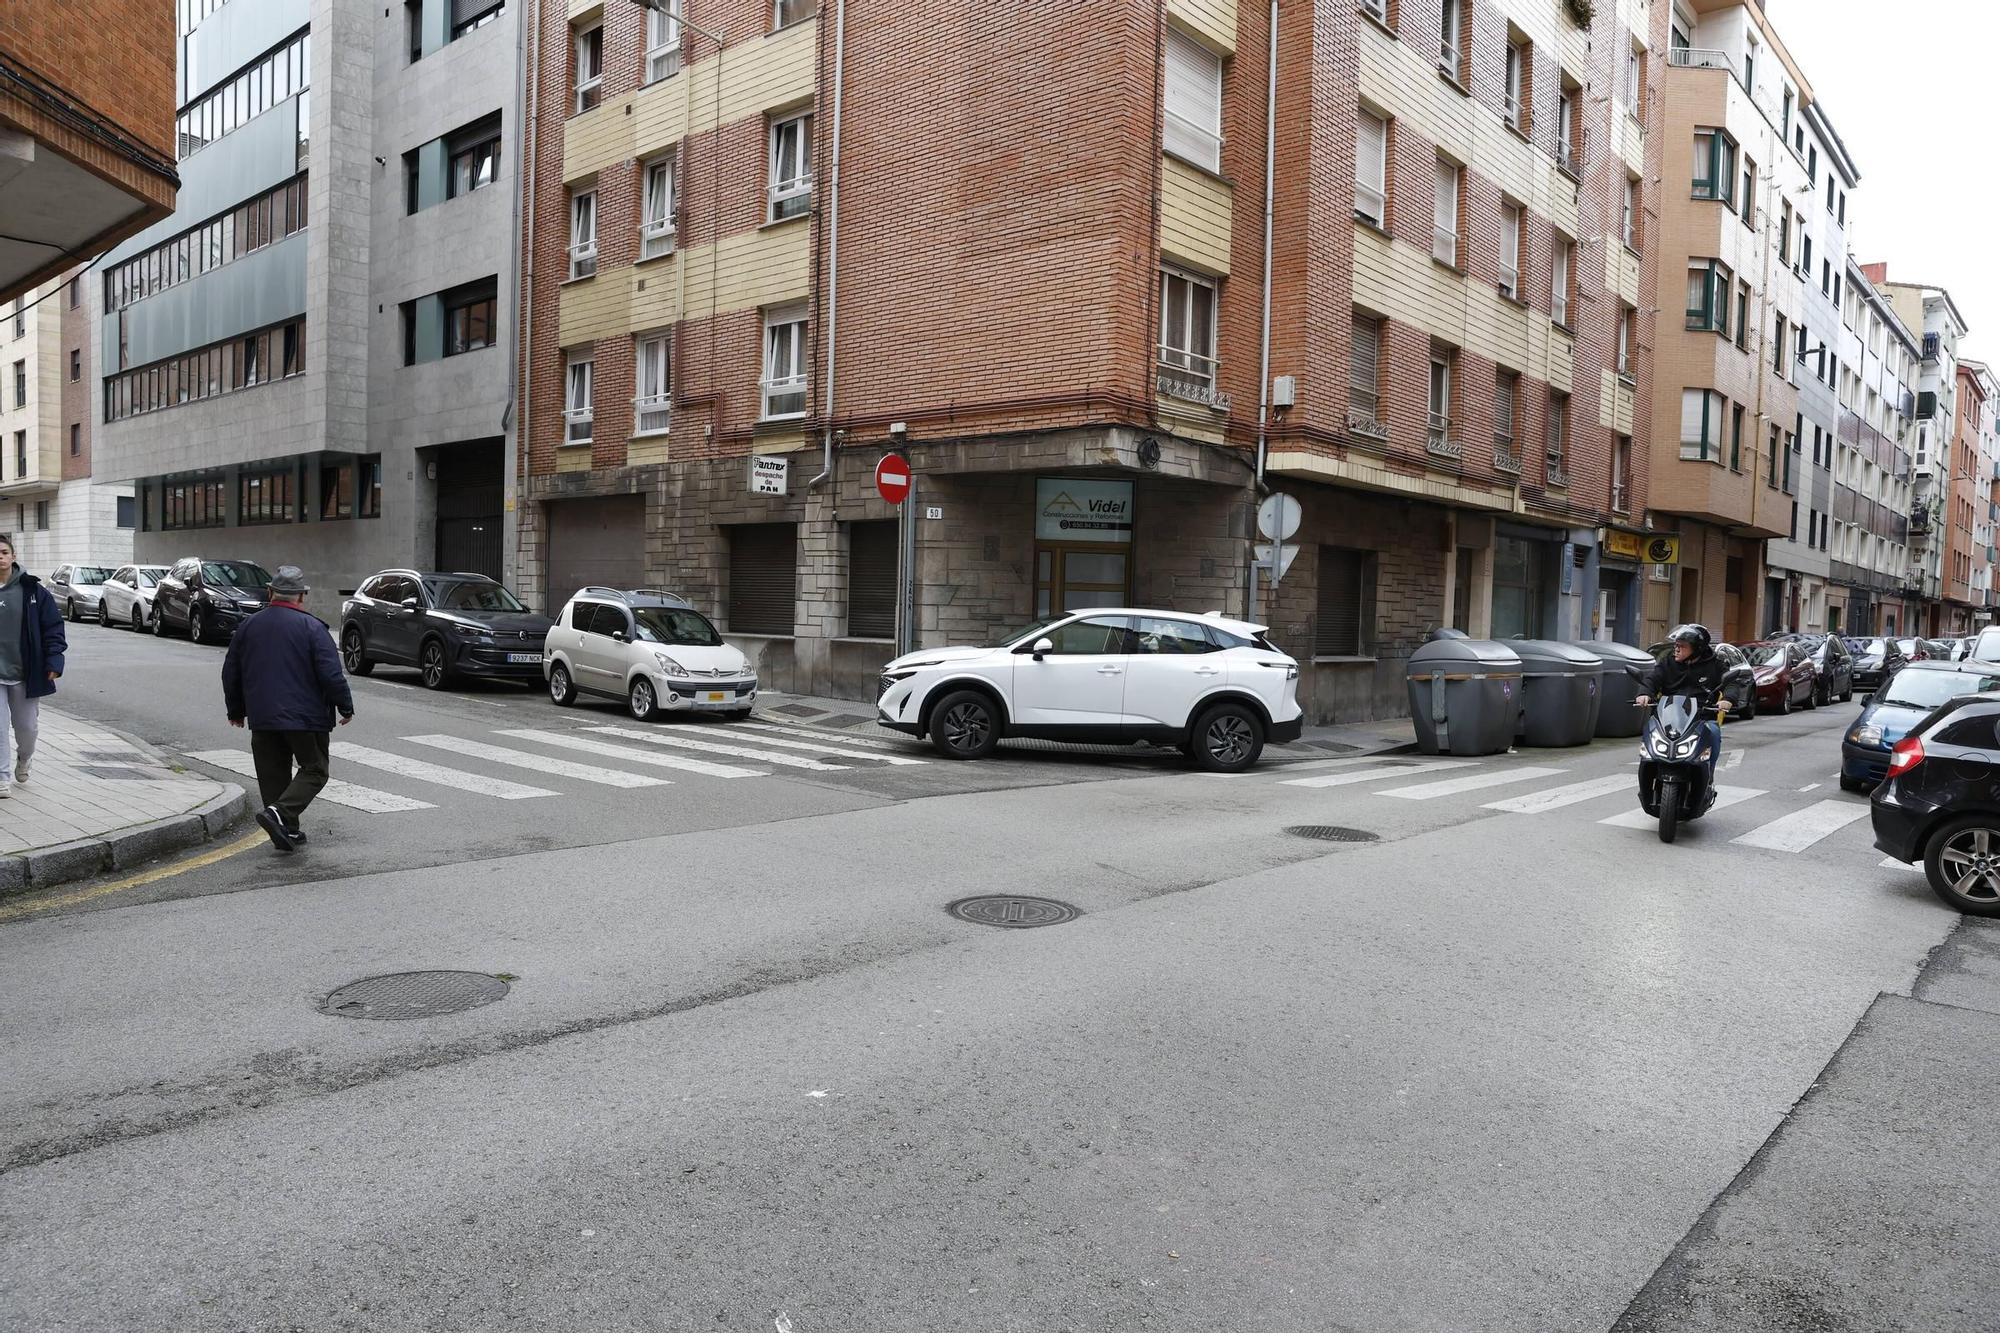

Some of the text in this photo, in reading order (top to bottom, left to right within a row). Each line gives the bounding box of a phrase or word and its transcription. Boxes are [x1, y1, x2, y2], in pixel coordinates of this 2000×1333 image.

[755, 471, 783, 479] despacho
[1088, 499, 1126, 513] Vidal
[930, 508, 939, 518] 50
[1042, 511, 1088, 519] Construcciones
